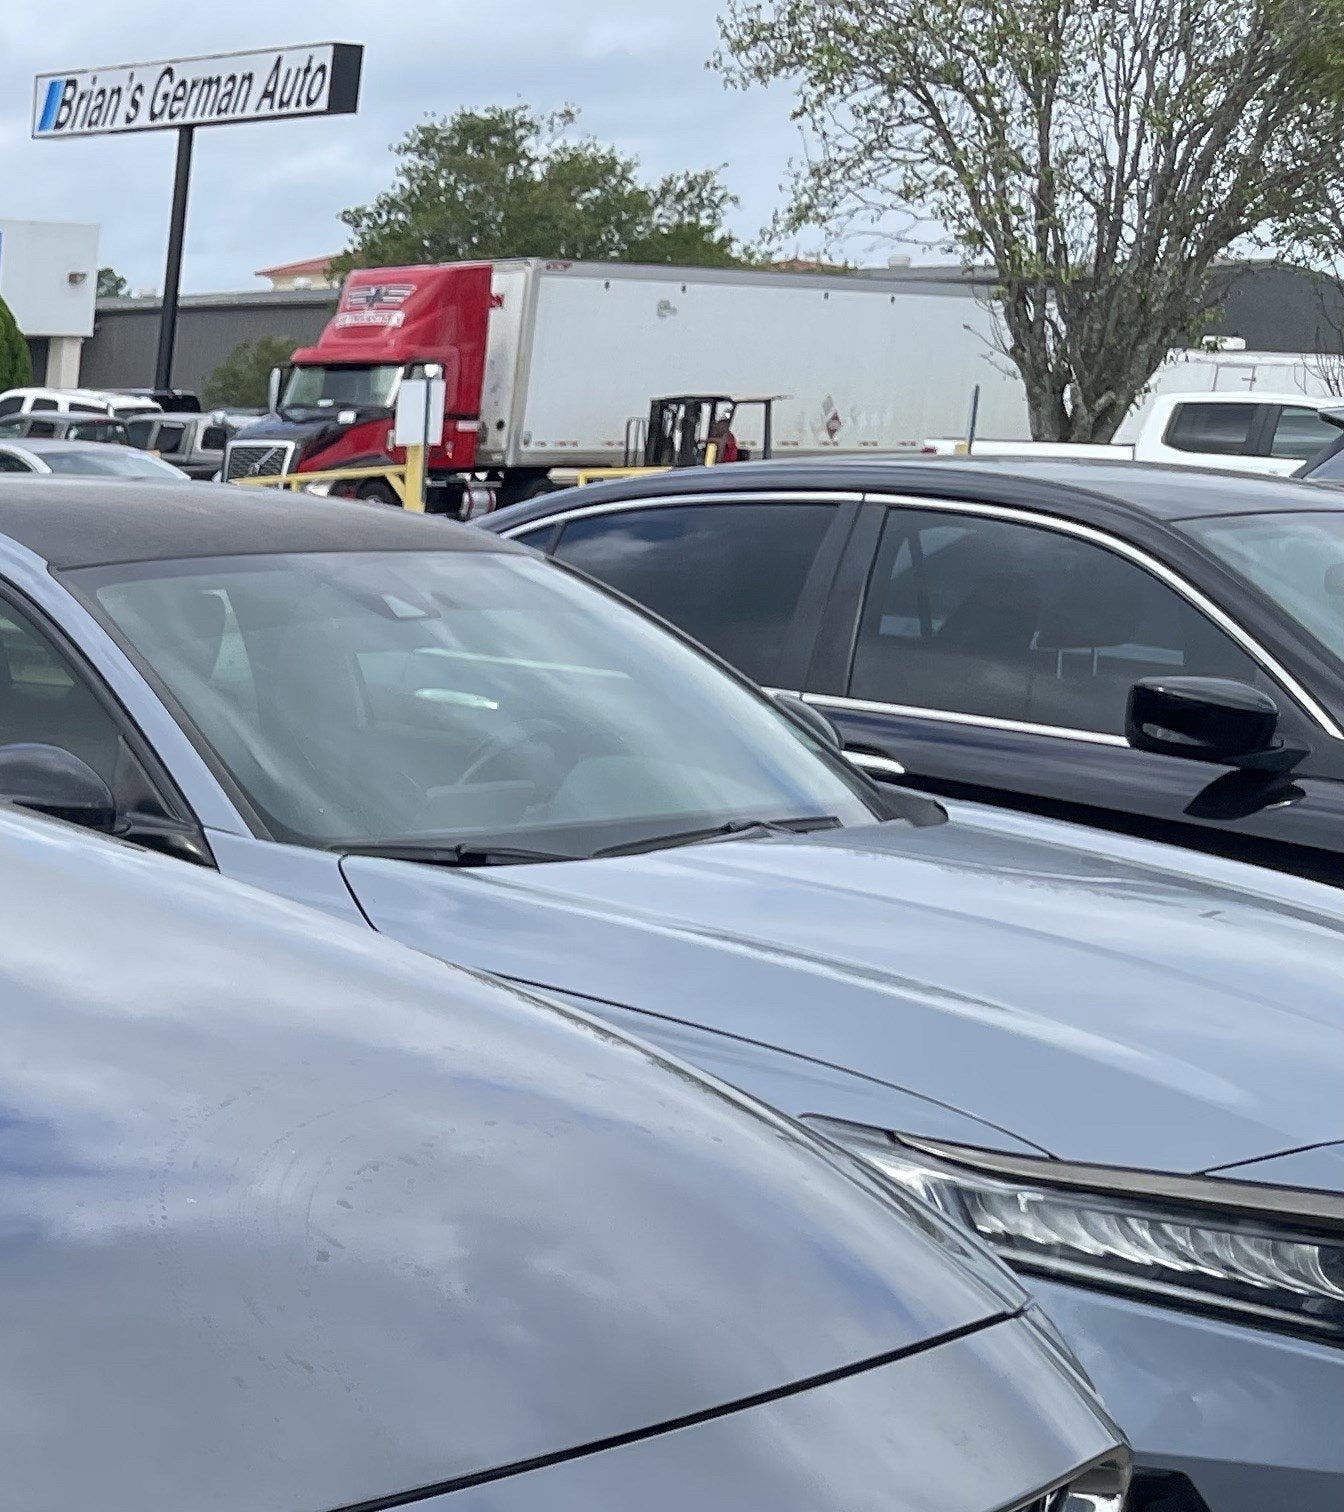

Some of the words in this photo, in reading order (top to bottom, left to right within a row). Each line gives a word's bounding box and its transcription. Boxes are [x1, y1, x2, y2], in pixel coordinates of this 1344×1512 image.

[53, 70, 146, 131] Brian's
[149, 64, 255, 121] German
[256, 54, 328, 112] Auto
